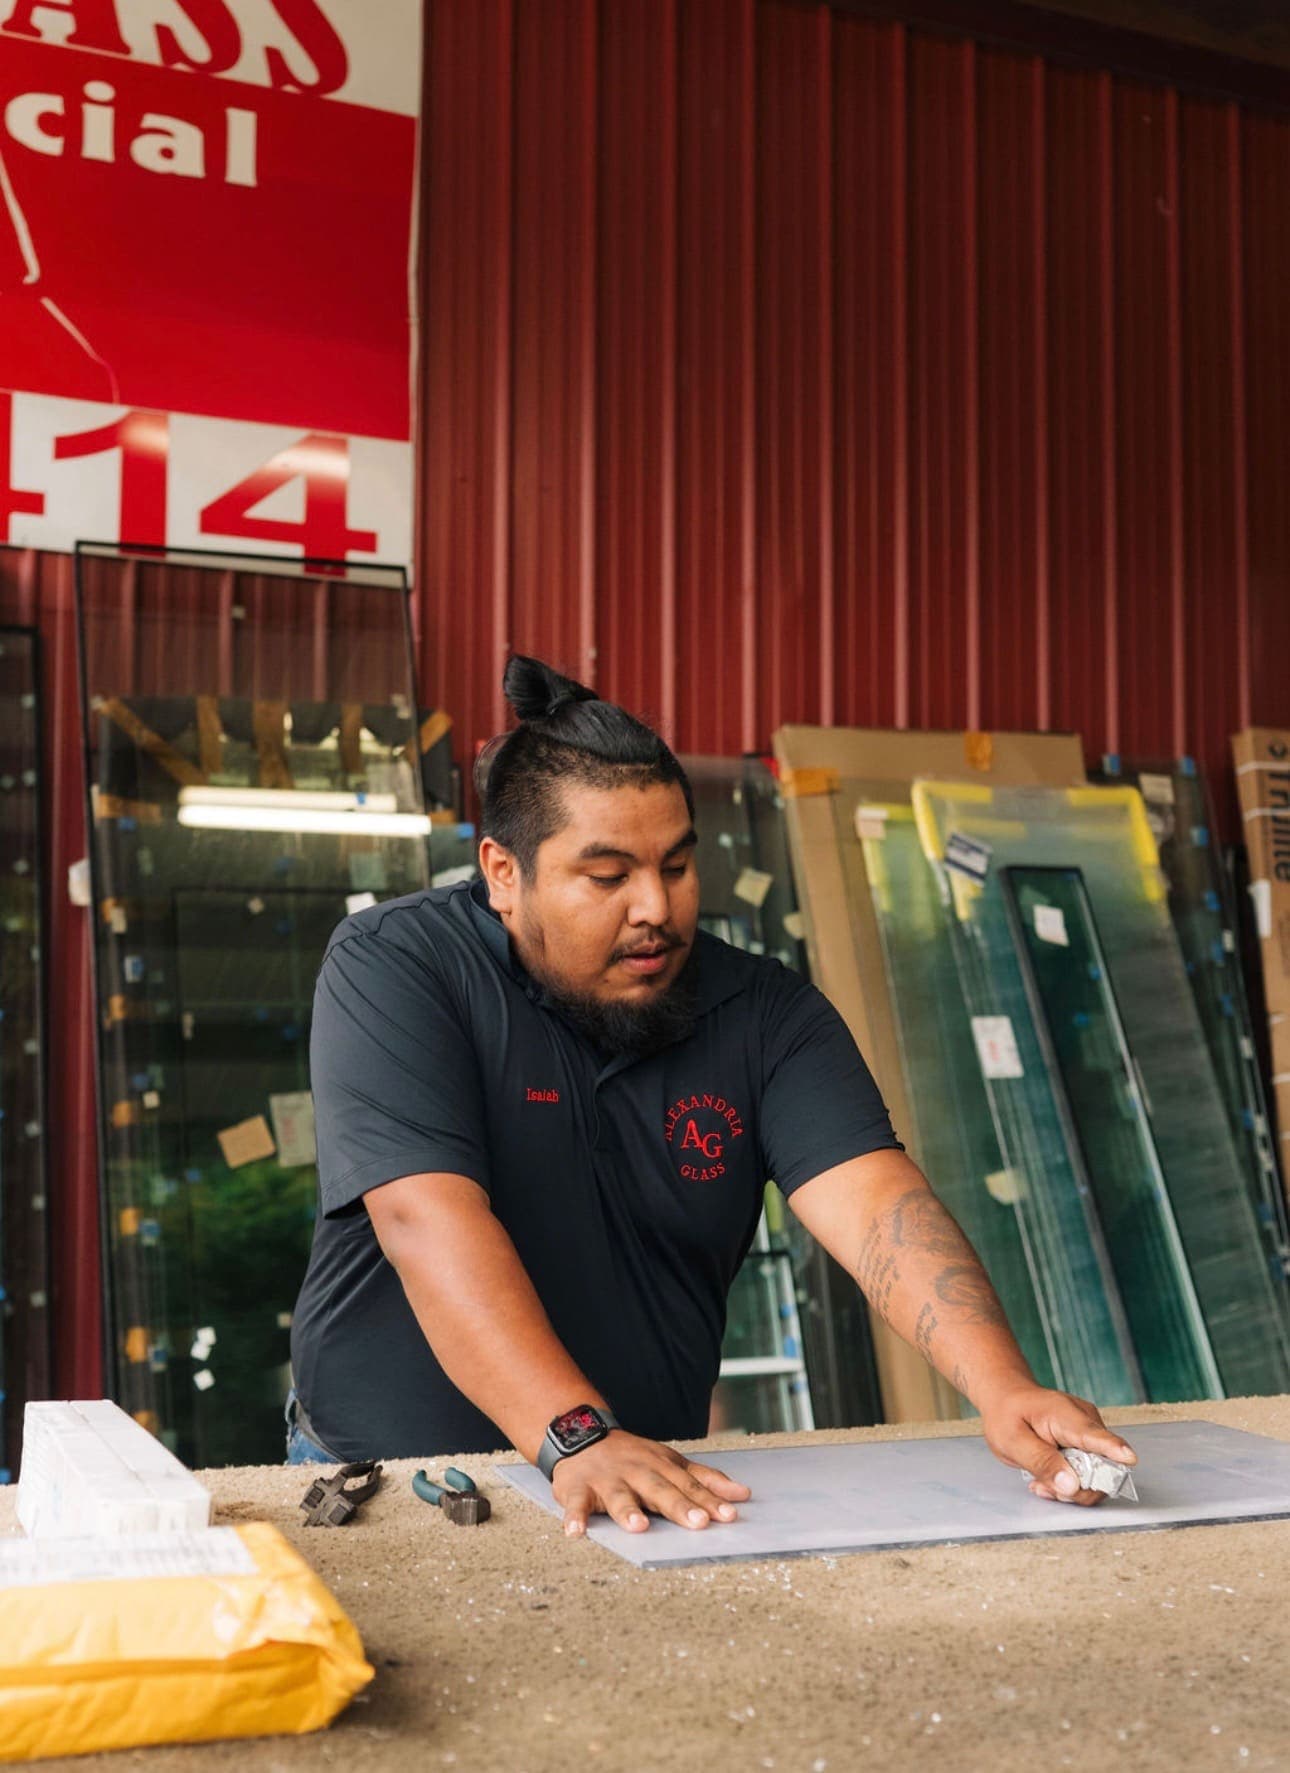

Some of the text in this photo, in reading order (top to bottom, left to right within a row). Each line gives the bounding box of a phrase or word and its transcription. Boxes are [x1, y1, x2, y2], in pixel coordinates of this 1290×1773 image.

[5, 81, 257, 187] cial
[526, 1087, 559, 1104] Isaiah
[664, 1094, 743, 1142] ALEXANDRIA
[681, 1119, 724, 1158] AG
[680, 1162, 726, 1180] GLASS
